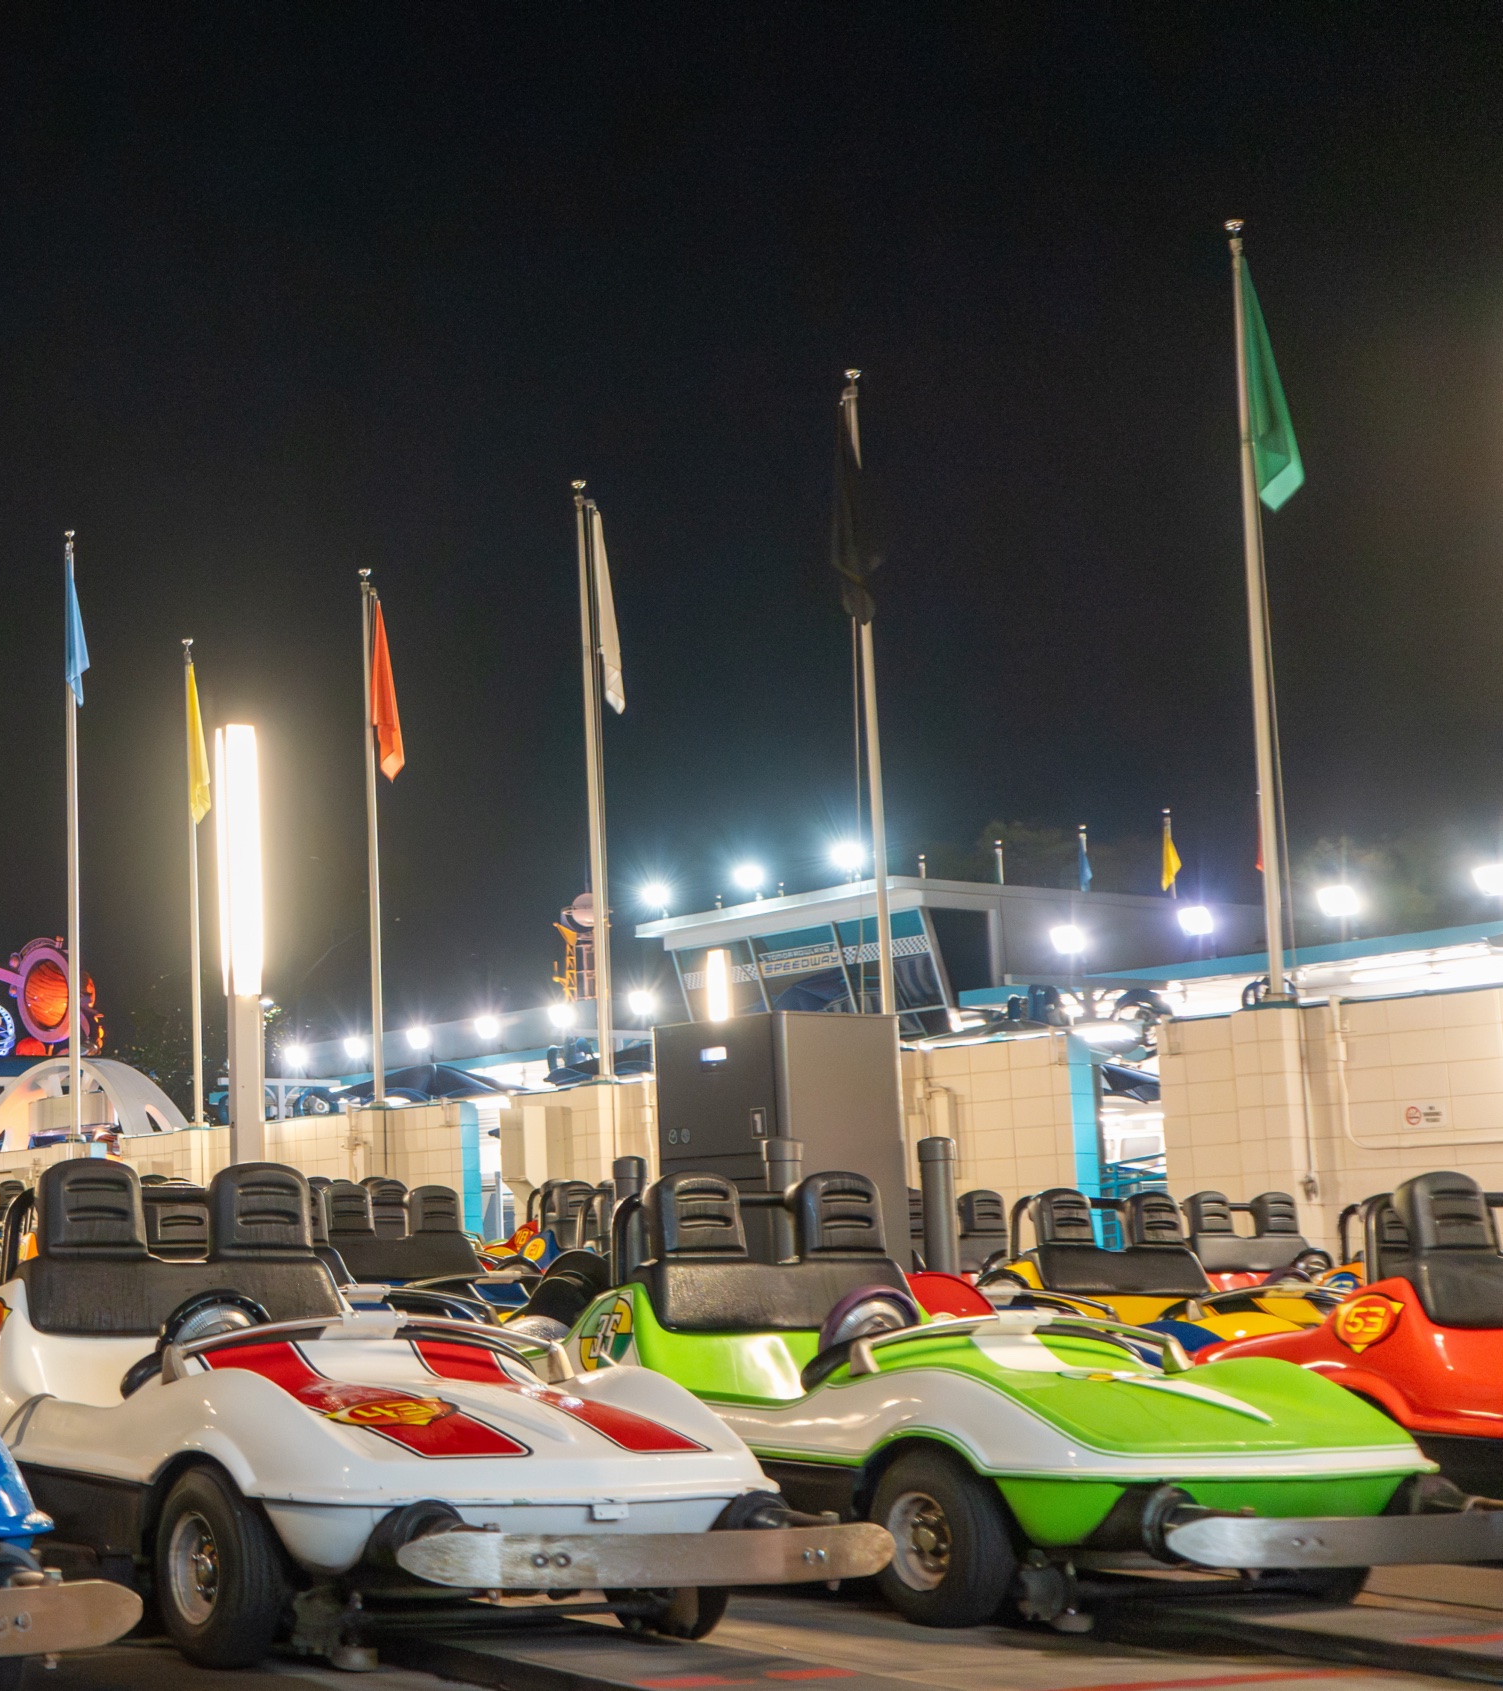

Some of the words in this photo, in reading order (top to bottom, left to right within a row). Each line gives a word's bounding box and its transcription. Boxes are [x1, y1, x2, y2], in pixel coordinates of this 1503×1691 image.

[765, 954, 839, 974] SPEEDWAY
[1344, 1306, 1387, 1334] 53
[589, 1312, 623, 1359] 35
[353, 1402, 434, 1419] 43
